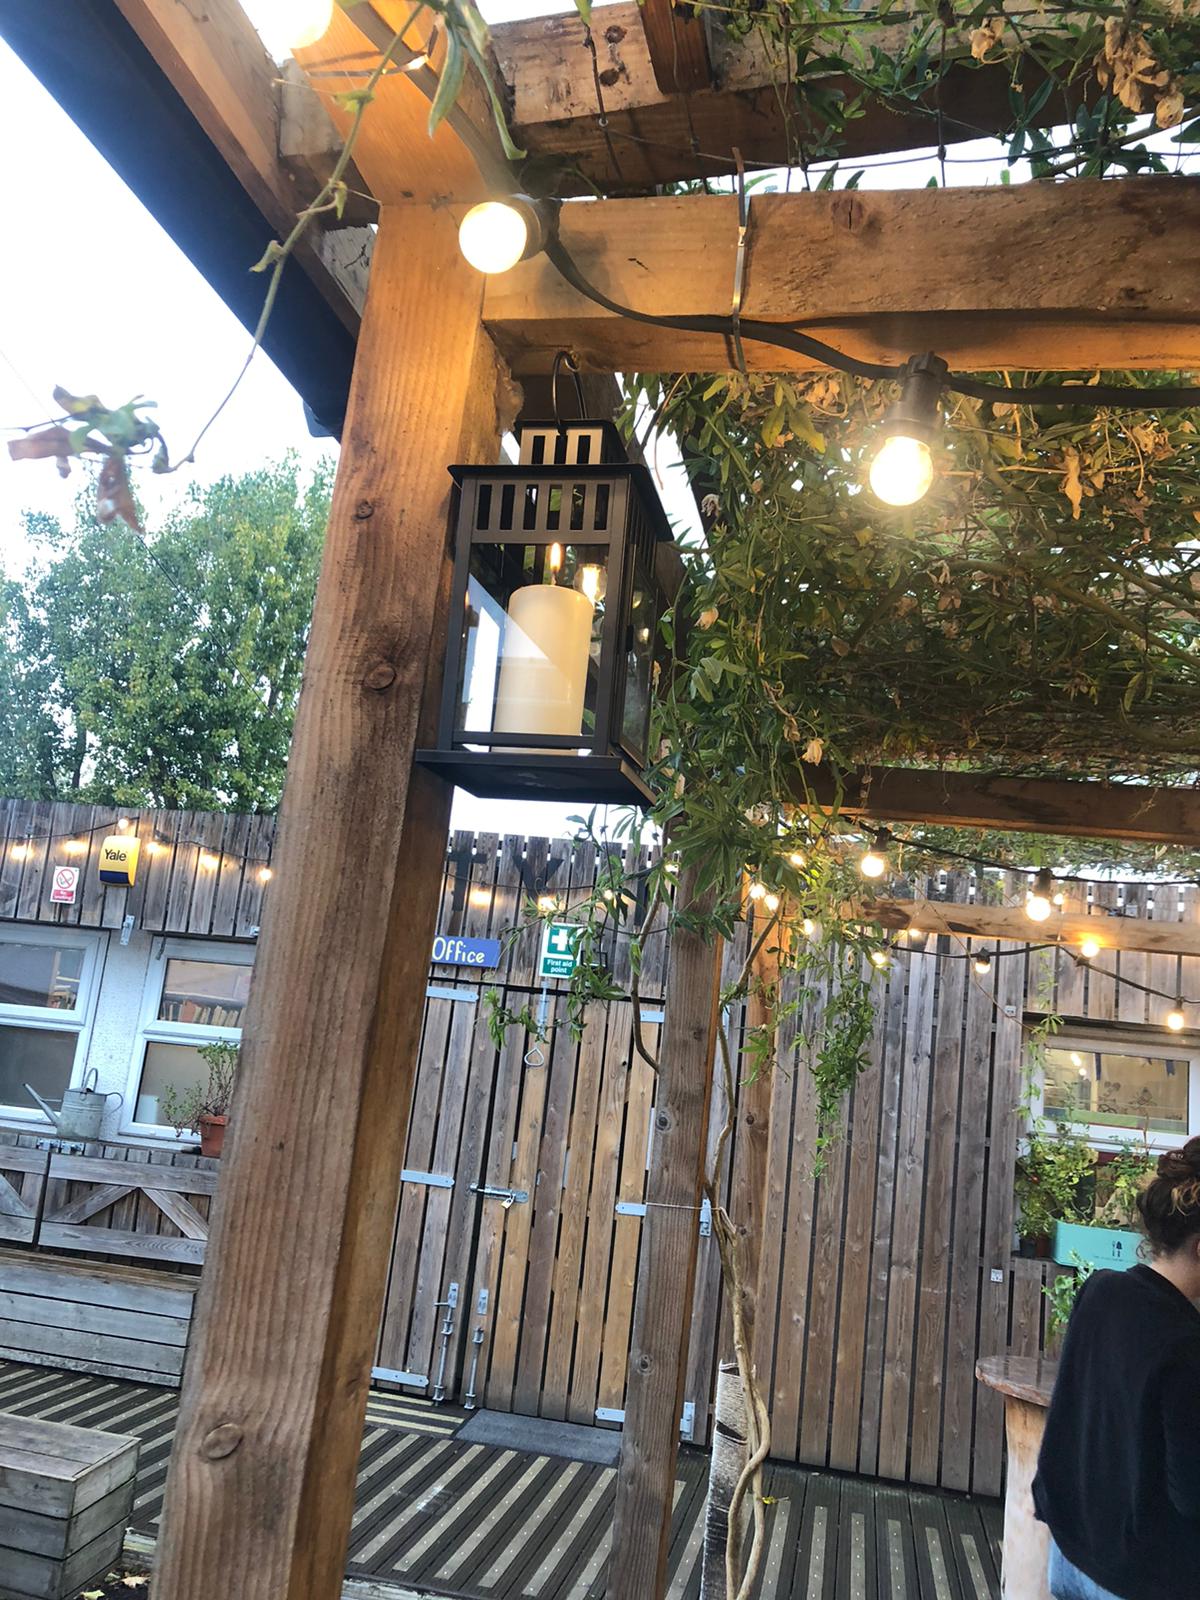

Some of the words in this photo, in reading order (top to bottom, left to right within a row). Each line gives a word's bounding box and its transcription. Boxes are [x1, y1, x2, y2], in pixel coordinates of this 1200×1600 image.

[104, 848, 127, 862] Yale
[431, 936, 485, 963] Office
[547, 958, 561, 966] First
[562, 960, 573, 968] aid
[550, 966, 567, 974] point
